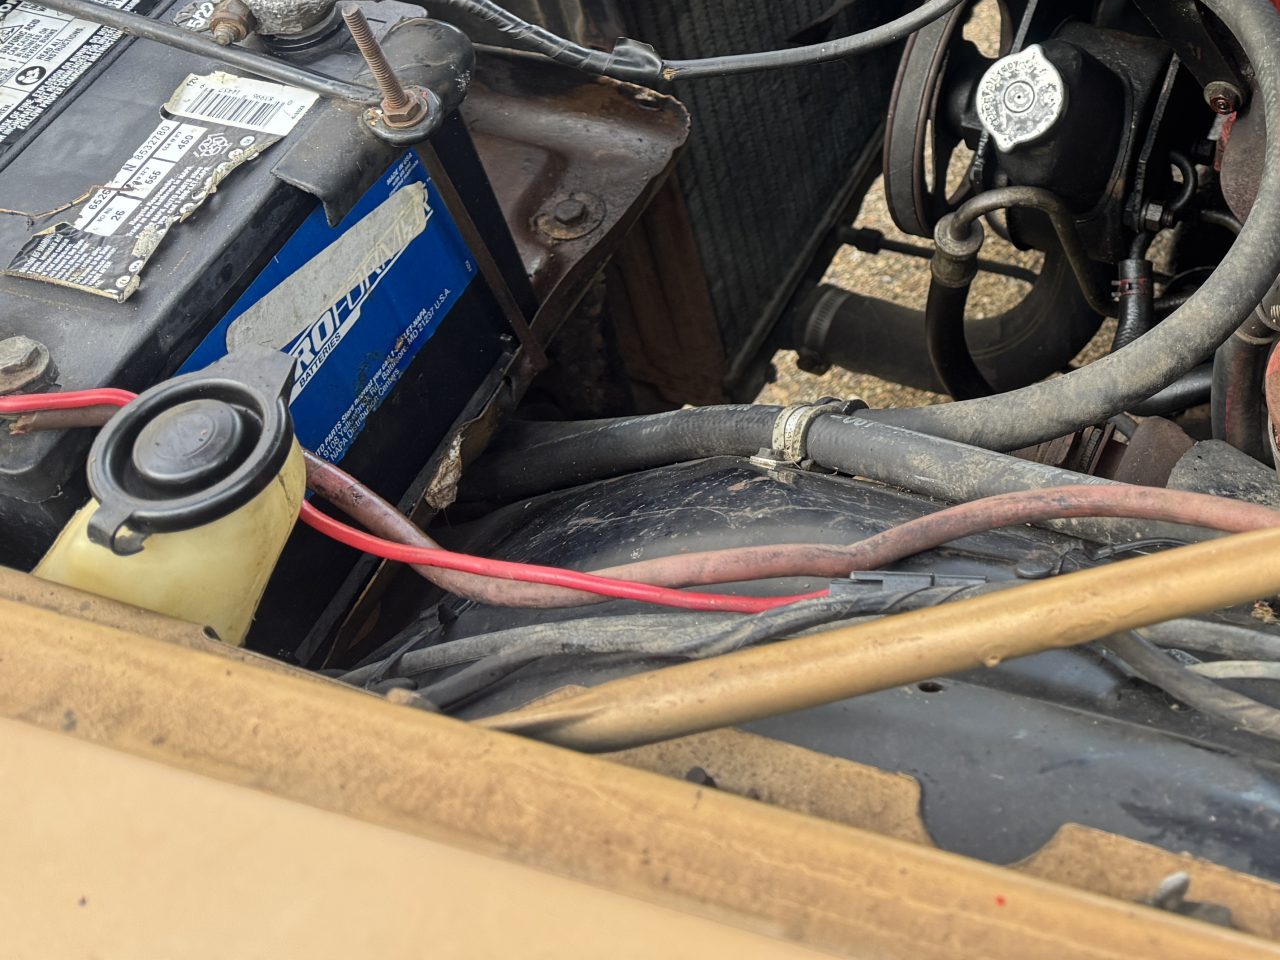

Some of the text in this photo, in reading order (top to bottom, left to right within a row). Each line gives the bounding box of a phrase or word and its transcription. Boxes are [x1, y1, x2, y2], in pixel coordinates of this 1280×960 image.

[35, 38, 63, 60] READ ALL
[43, 25, 86, 62] INSTRUCTIONS.
[86, 188, 112, 210] 6526
[120, 162, 137, 172] N
[109, 209, 126, 221] 26
[414, 307, 438, 332] 21237
[298, 332, 342, 387] BATTERIES
[320, 420, 345, 445] PARTS
[327, 436, 350, 461] NAPA
